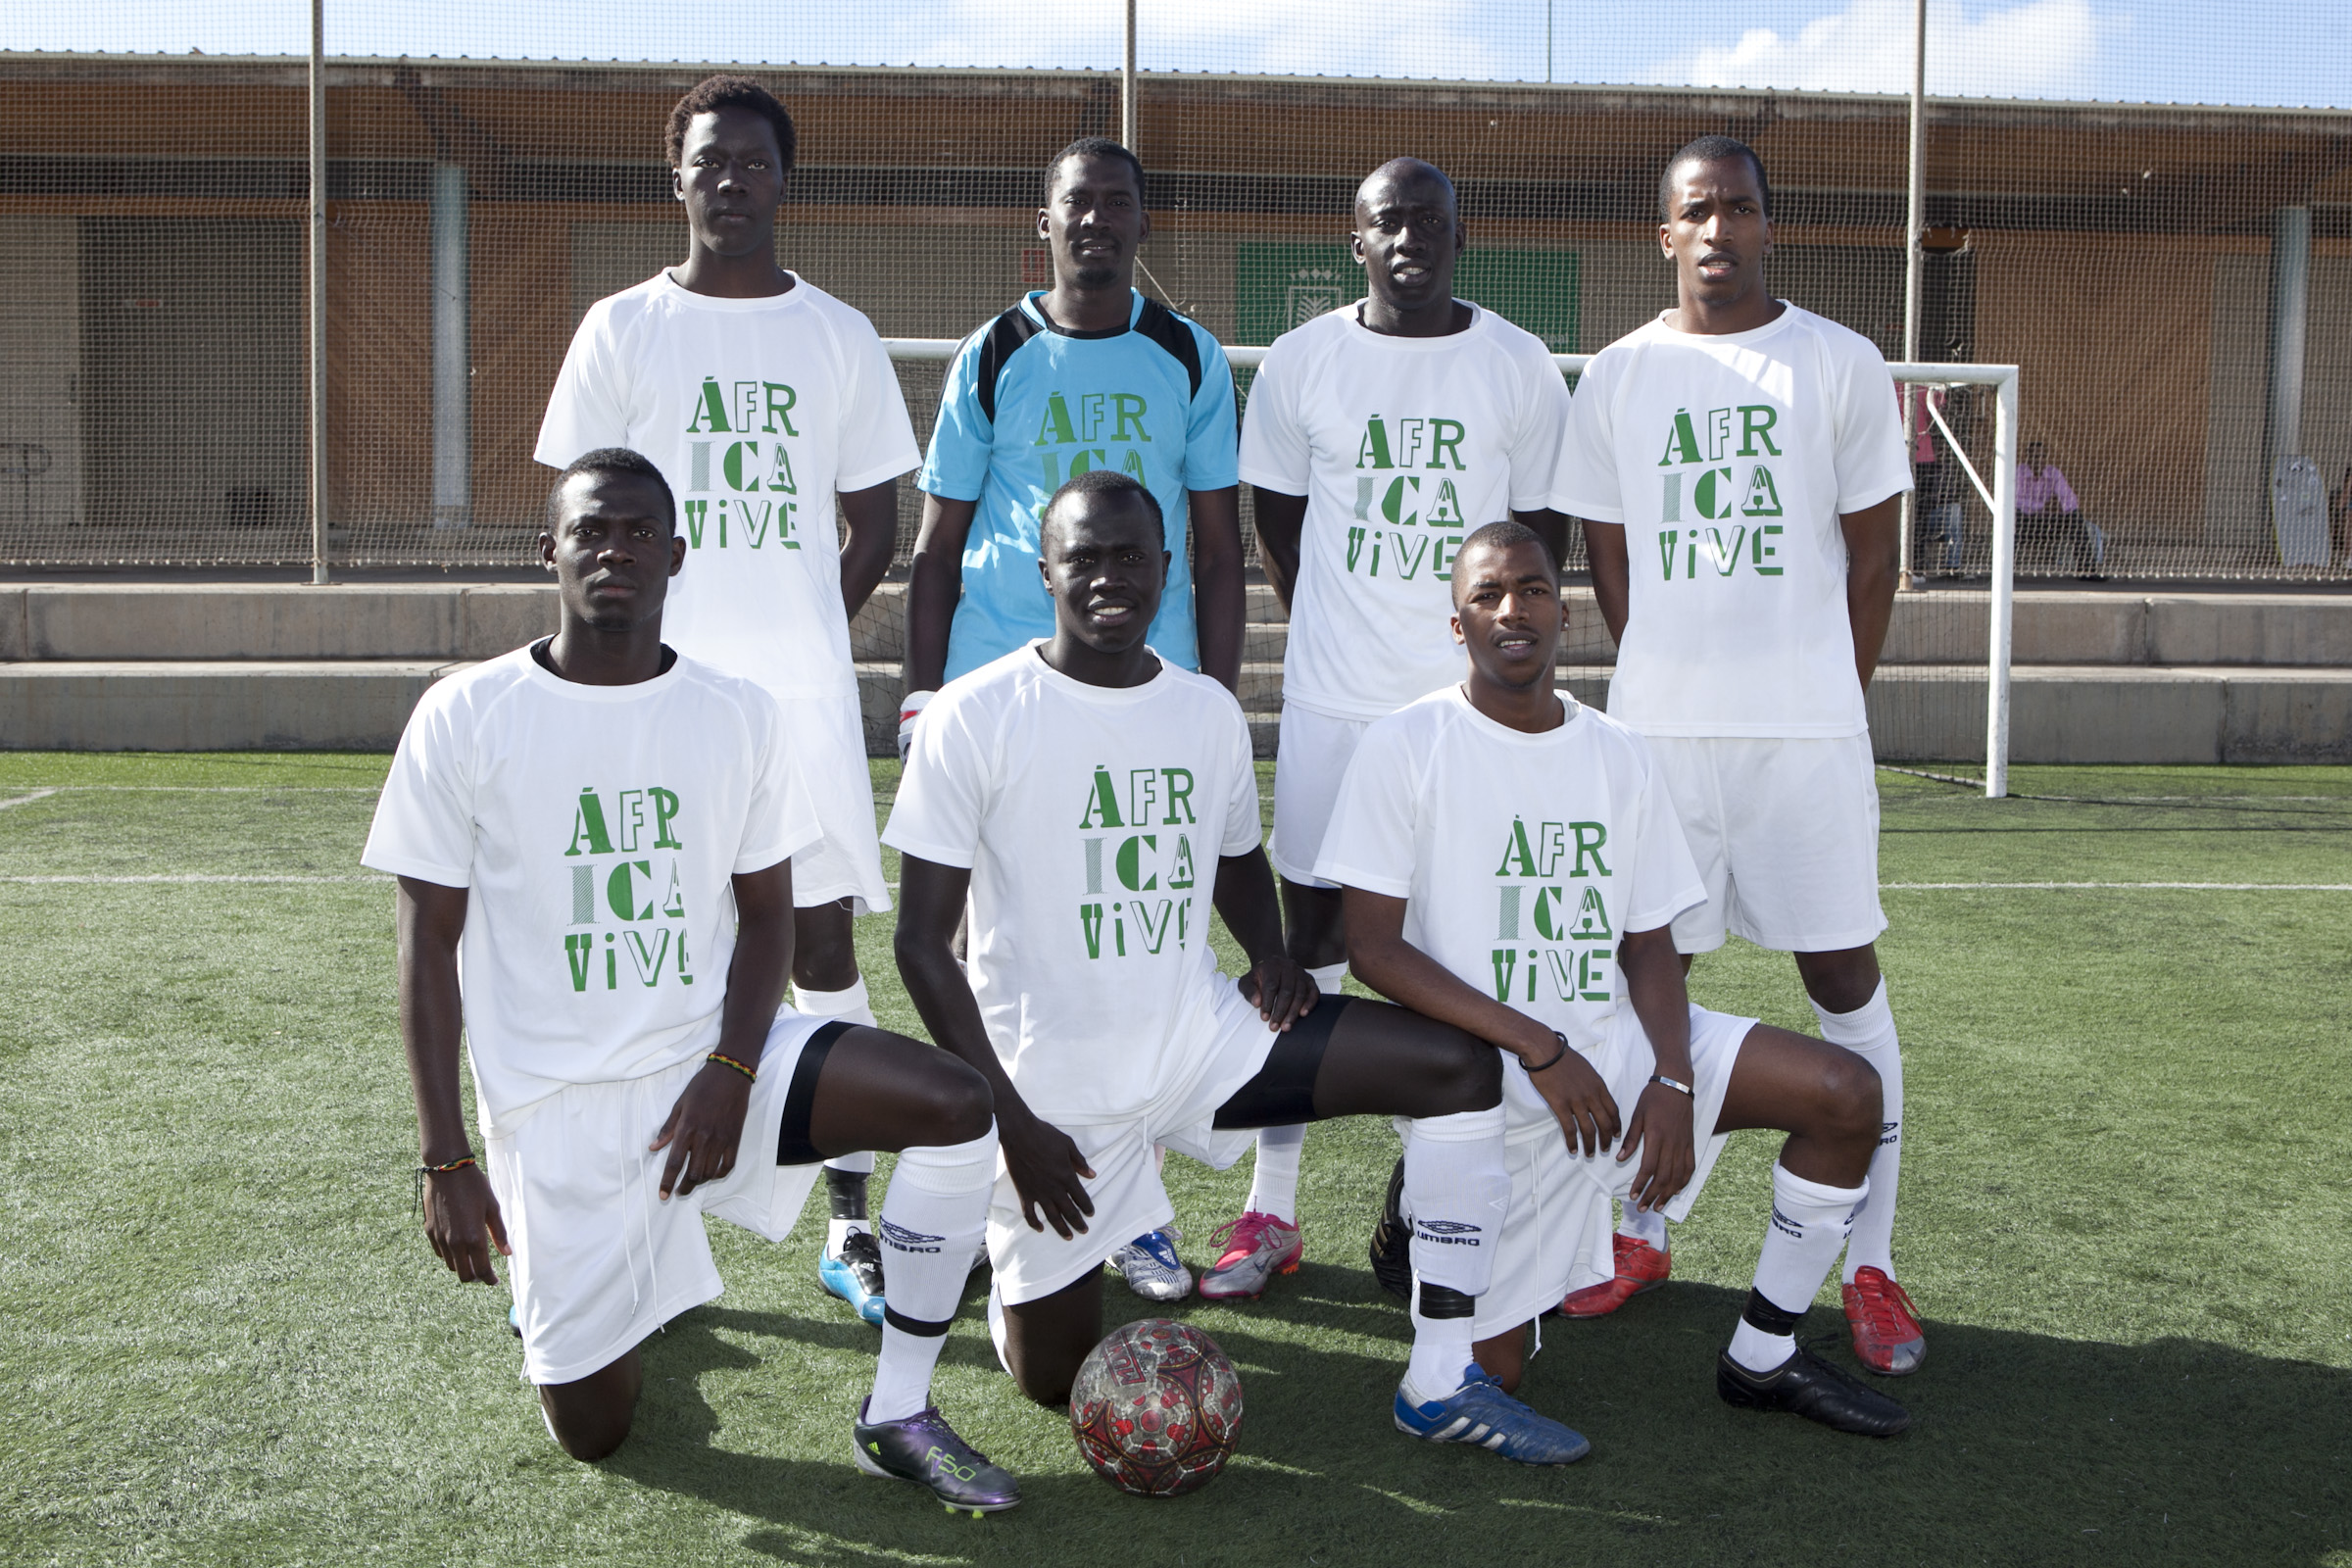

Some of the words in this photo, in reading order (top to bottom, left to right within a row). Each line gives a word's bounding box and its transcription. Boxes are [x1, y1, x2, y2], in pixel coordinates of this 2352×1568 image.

[685, 375, 800, 437] ÁFR
[1034, 391, 1152, 447] ÁFR
[1355, 414, 1467, 471] ÁFR
[1657, 405, 1783, 466] ÁFR
[685, 441, 798, 496] ICA
[1657, 465, 1784, 524] ICA
[1353, 475, 1465, 528] ICA
[1078, 764, 1197, 829] ÁFR
[1080, 833, 1195, 897] ICA
[1494, 885, 1613, 942] ICA
[880, 1230, 941, 1253] MBRO
[1417, 1230, 1480, 1247] UMBRO
[924, 1446, 977, 1483] F50
